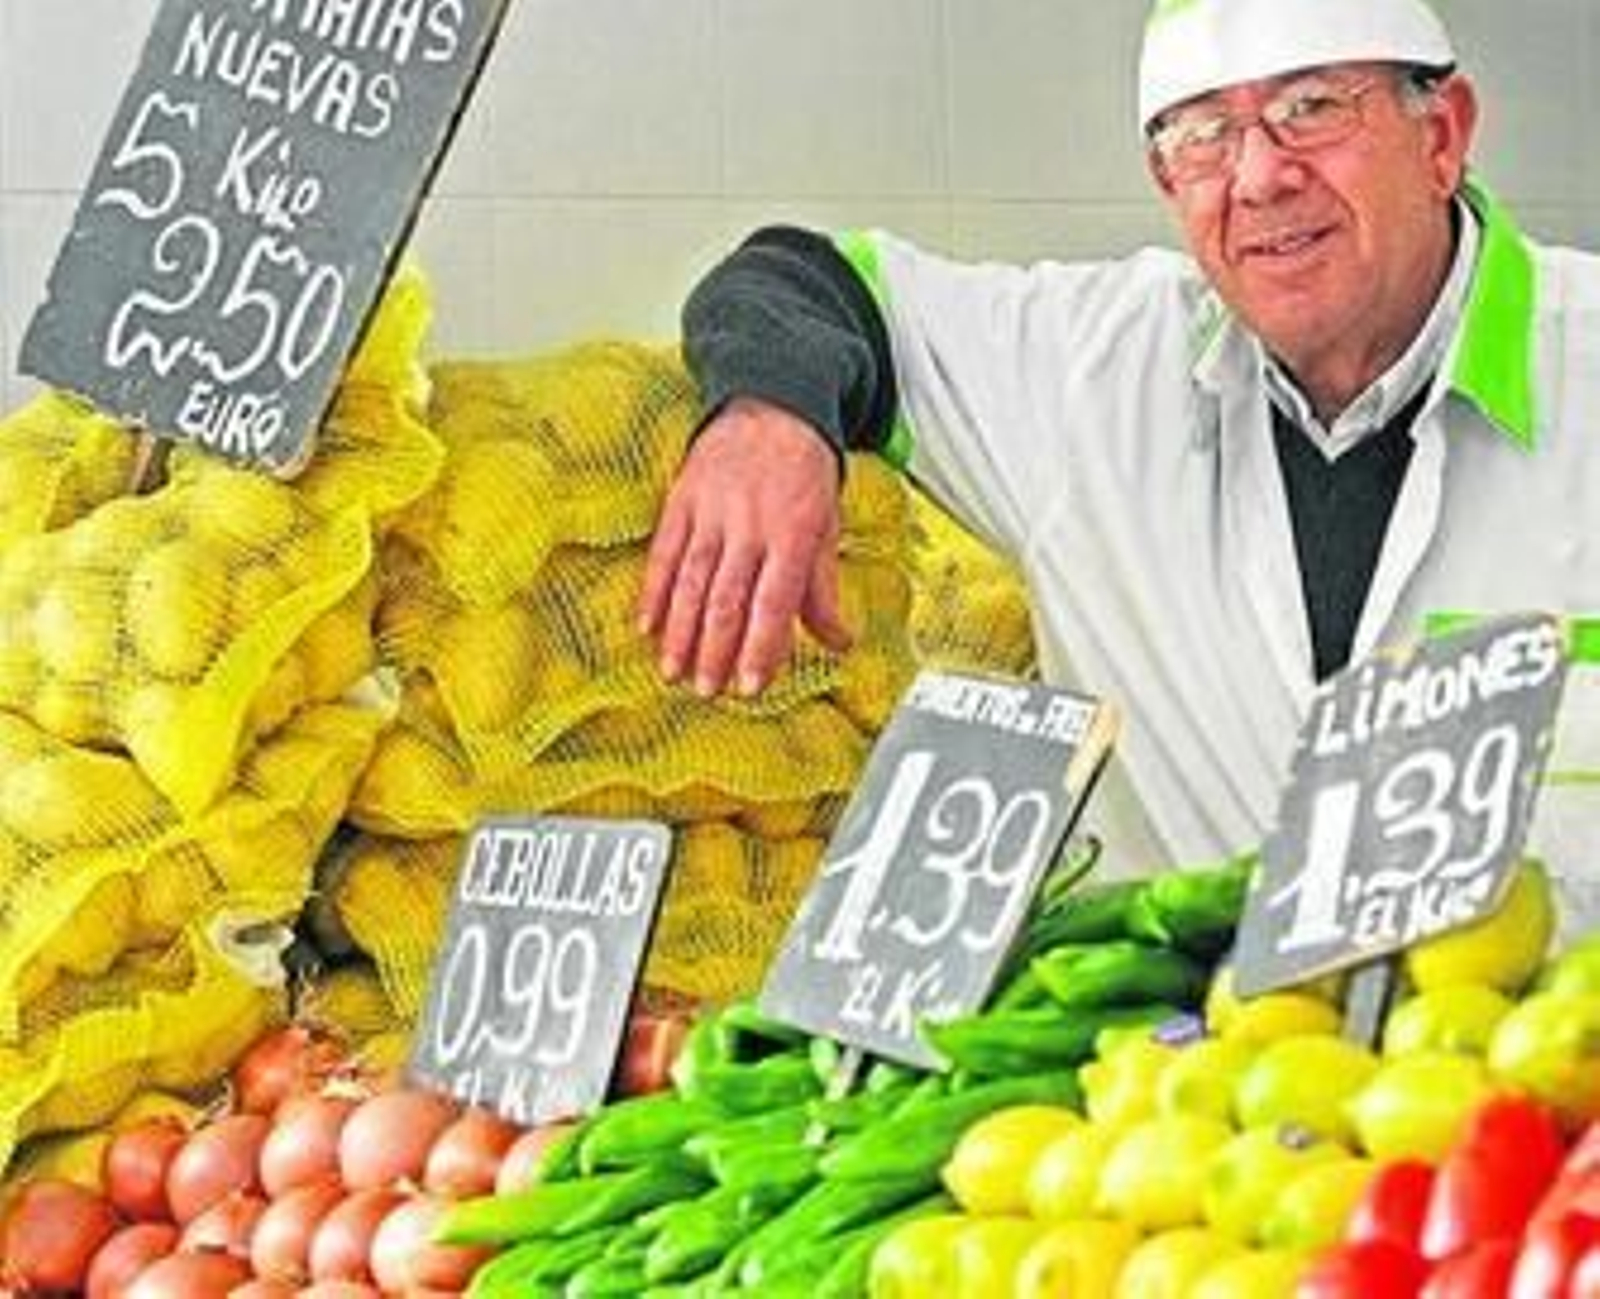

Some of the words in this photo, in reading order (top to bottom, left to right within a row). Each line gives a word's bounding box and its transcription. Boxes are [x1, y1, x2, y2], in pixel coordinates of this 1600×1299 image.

[174, 12, 398, 137] NUEVAS
[99, 92, 197, 219] 5
[177, 382, 284, 453] EURO
[461, 828, 654, 916] CEBOLLAS
